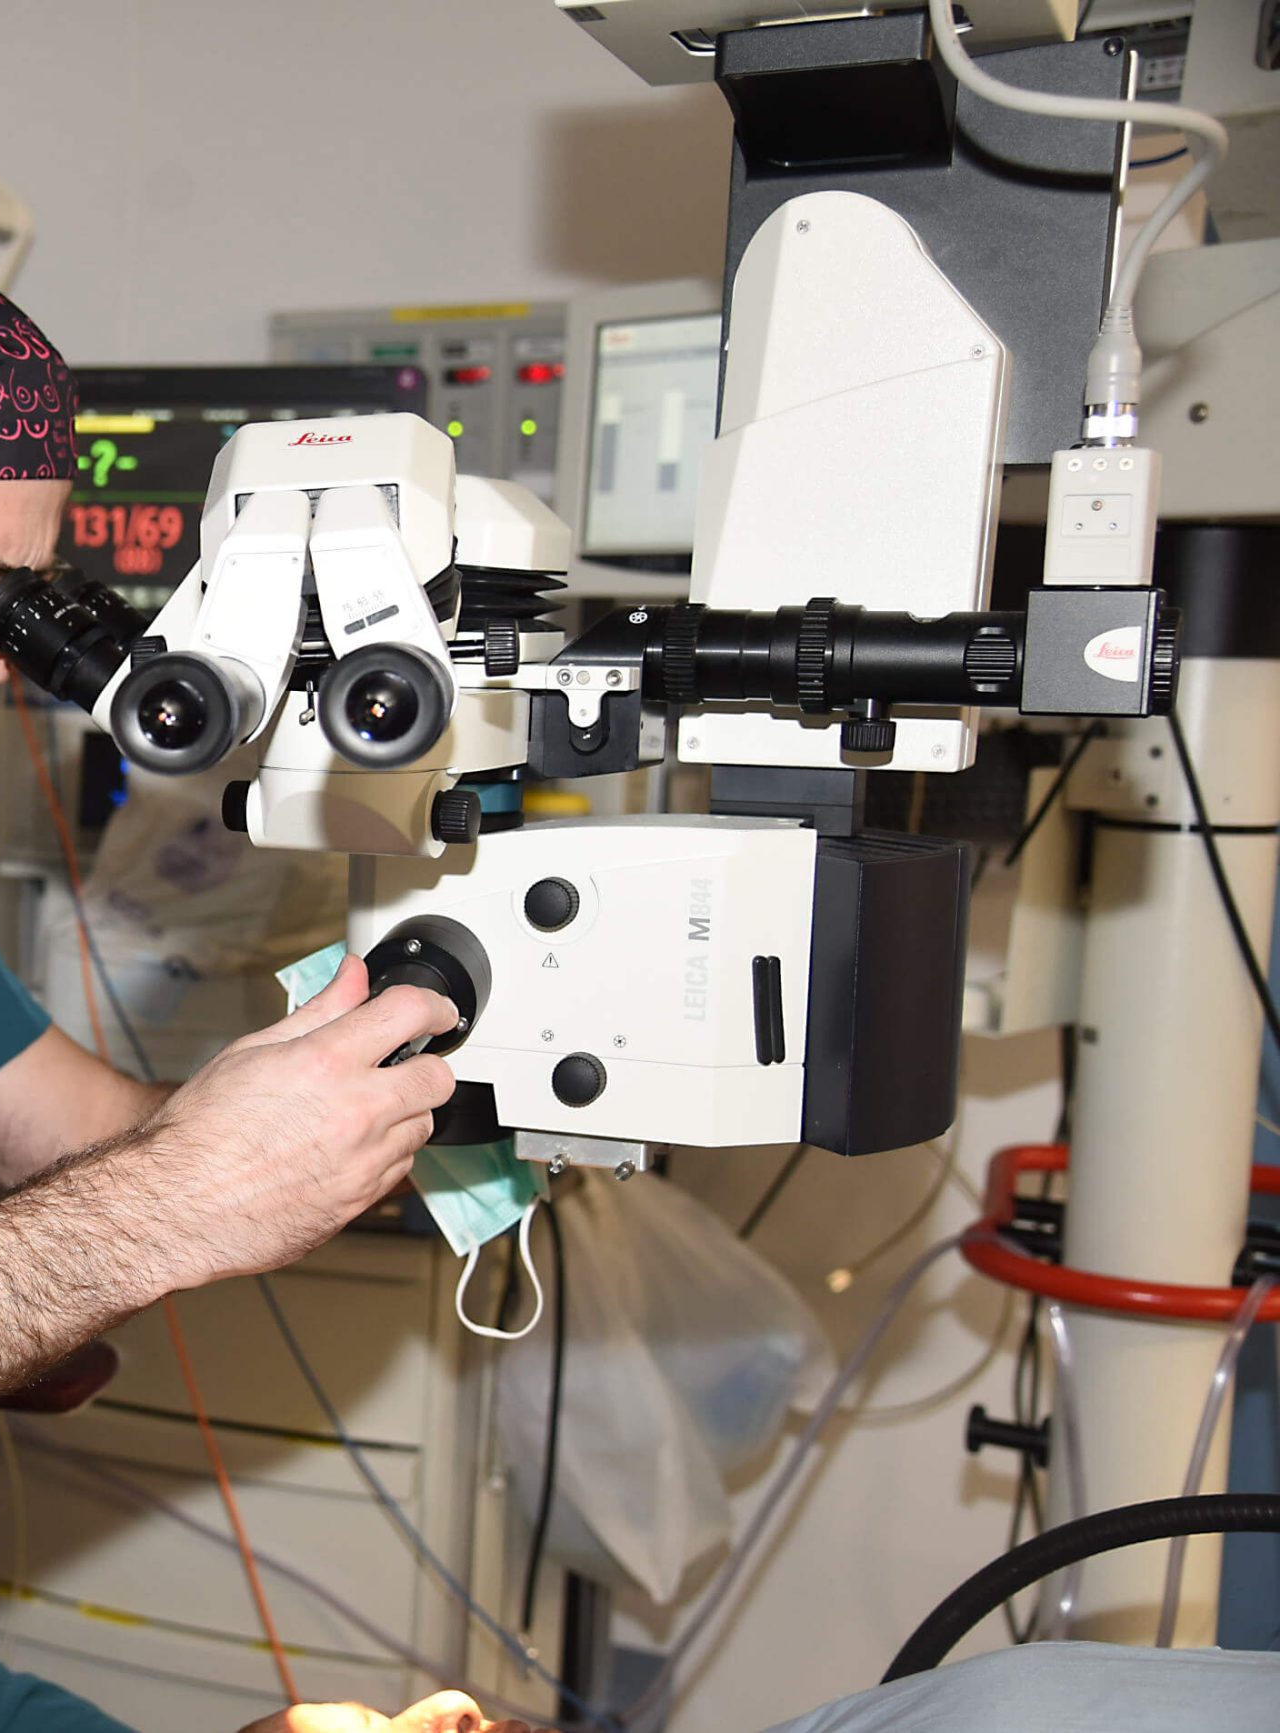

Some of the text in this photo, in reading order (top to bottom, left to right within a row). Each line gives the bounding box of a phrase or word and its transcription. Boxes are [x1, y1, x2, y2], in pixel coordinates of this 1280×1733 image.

[288, 432, 353, 446] Leica
[71, 504, 184, 549] 131/69
[1094, 641, 1134, 660] Leica
[683, 878, 712, 1021] LEICA M844
